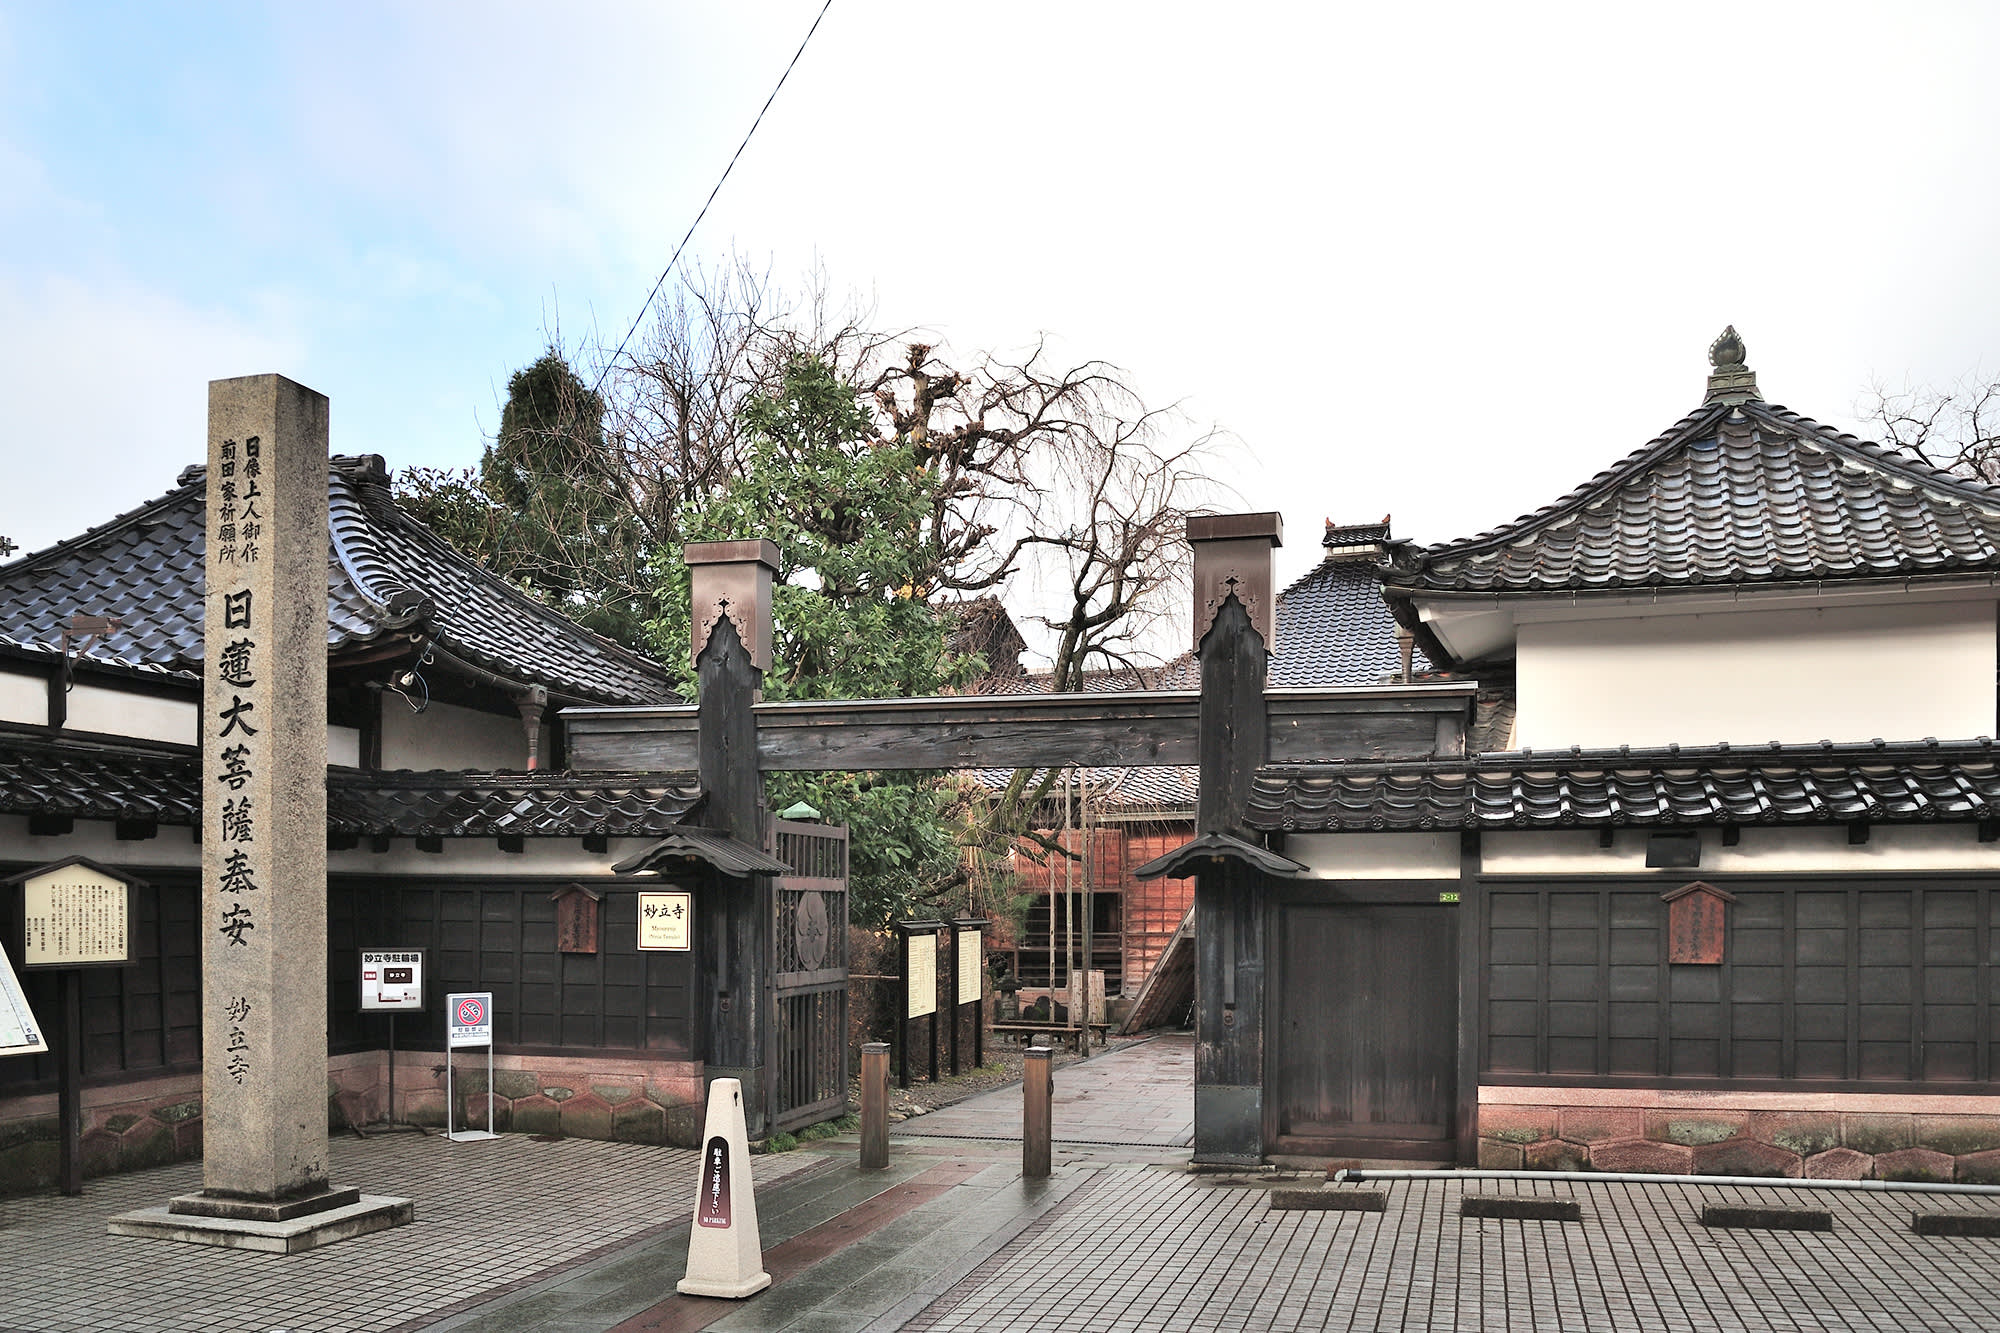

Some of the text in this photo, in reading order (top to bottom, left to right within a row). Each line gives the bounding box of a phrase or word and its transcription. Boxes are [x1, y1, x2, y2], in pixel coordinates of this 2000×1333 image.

[217, 439, 238, 566] 前田家祈願所
[239, 435, 263, 564] 日像上人御作
[643, 903, 685, 920] 妙立寺
[364, 954, 419, 963] 妙立寺駐輪場
[224, 996, 252, 1085] 妙立寺
[711, 1147, 723, 1215] 駐車ご遠慮下さい
